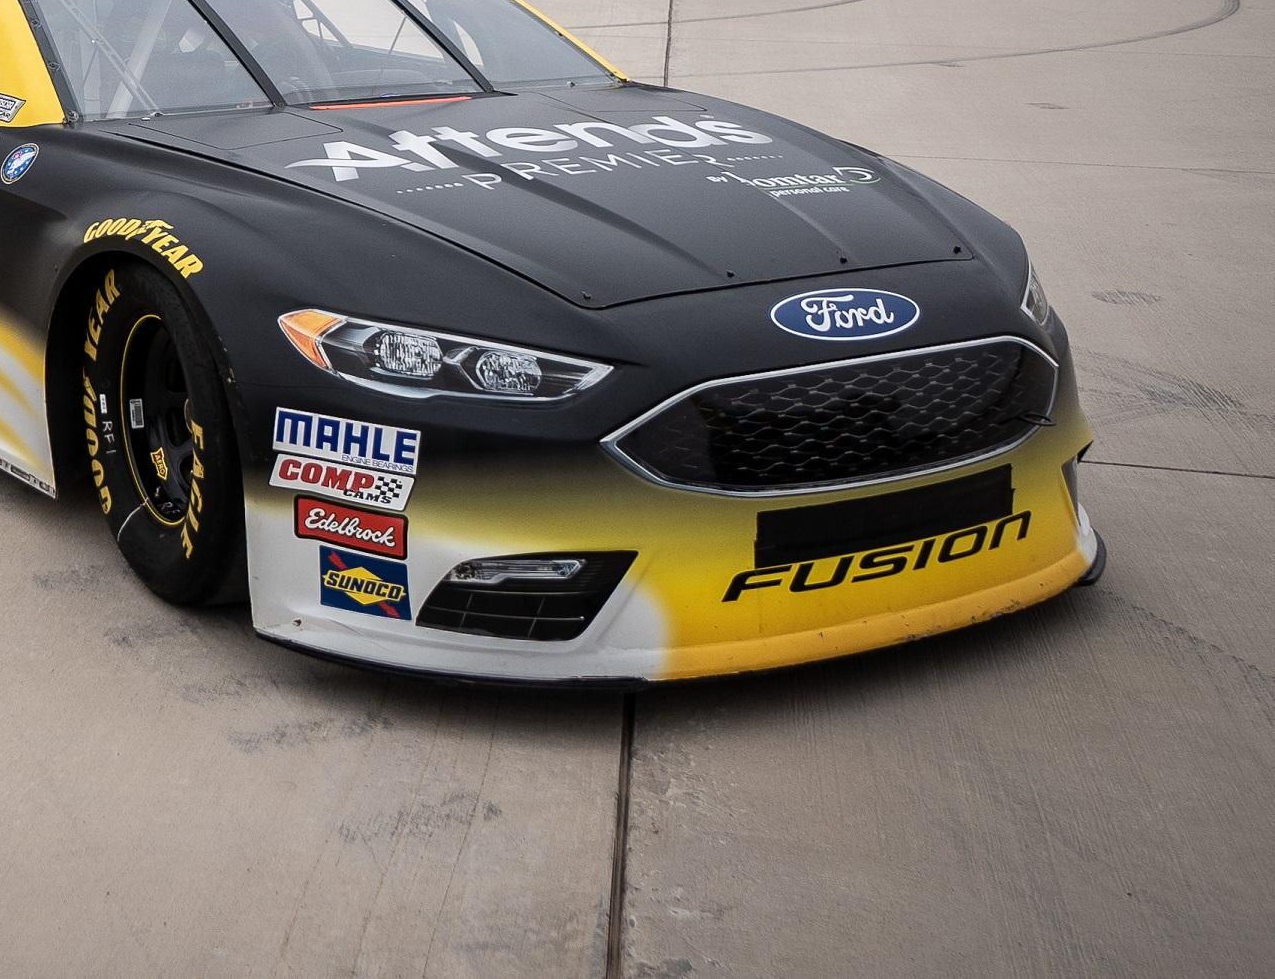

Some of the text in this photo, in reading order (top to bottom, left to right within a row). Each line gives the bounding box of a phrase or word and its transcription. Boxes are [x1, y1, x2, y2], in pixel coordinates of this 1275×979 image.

[284, 115, 773, 182] Attends
[463, 149, 735, 191] PREMIER
[771, 187, 824, 198] personal
[800, 294, 894, 332] Ford
[275, 410, 418, 466] MAHLE
[278, 458, 374, 493] COMP
[341, 455, 414, 472] ENGINE BEARINGS
[343, 489, 393, 504] CAMS
[305, 507, 396, 548] Edelbrock
[721, 510, 1032, 603] FUSION
[326, 572, 403, 600] SUNOCO
